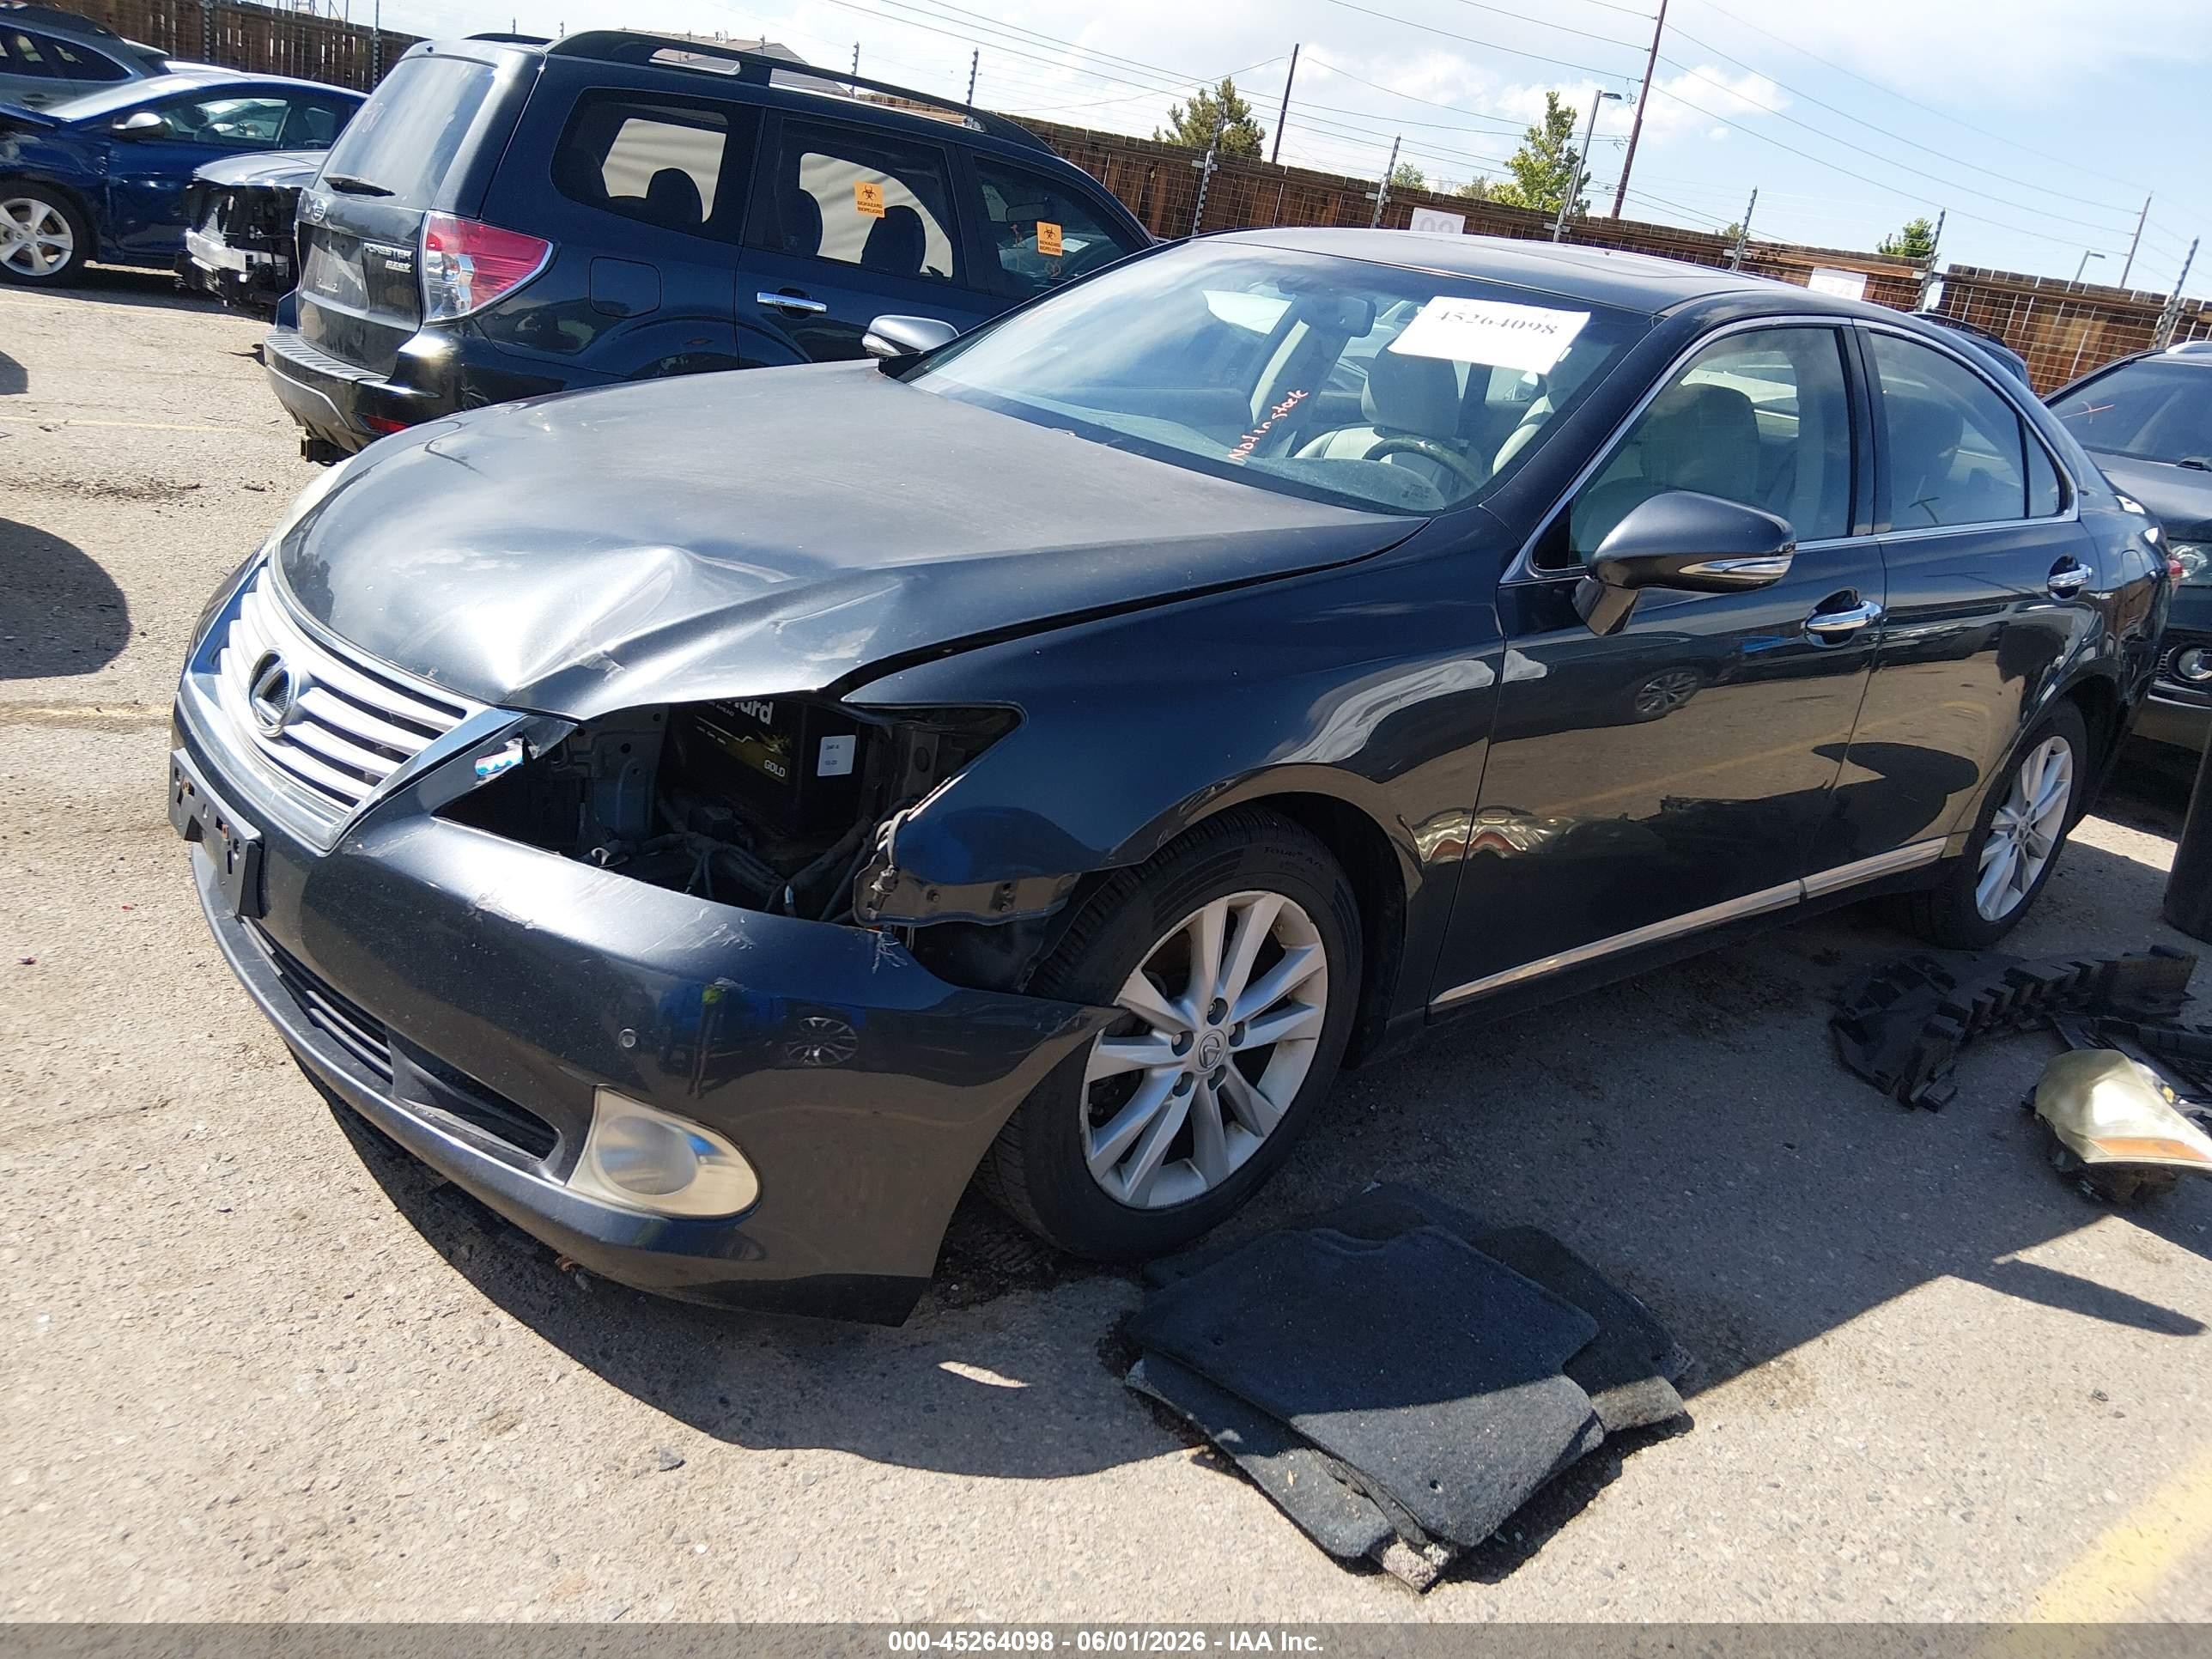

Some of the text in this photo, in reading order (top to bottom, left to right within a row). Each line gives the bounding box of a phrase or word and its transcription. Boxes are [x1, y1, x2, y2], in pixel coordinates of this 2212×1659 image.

[363, 242, 412, 260] FORESTER
[385, 259, 413, 270] PZEV
[1436, 310, 1559, 335] 45264098
[763, 759, 787, 778] GOLD
